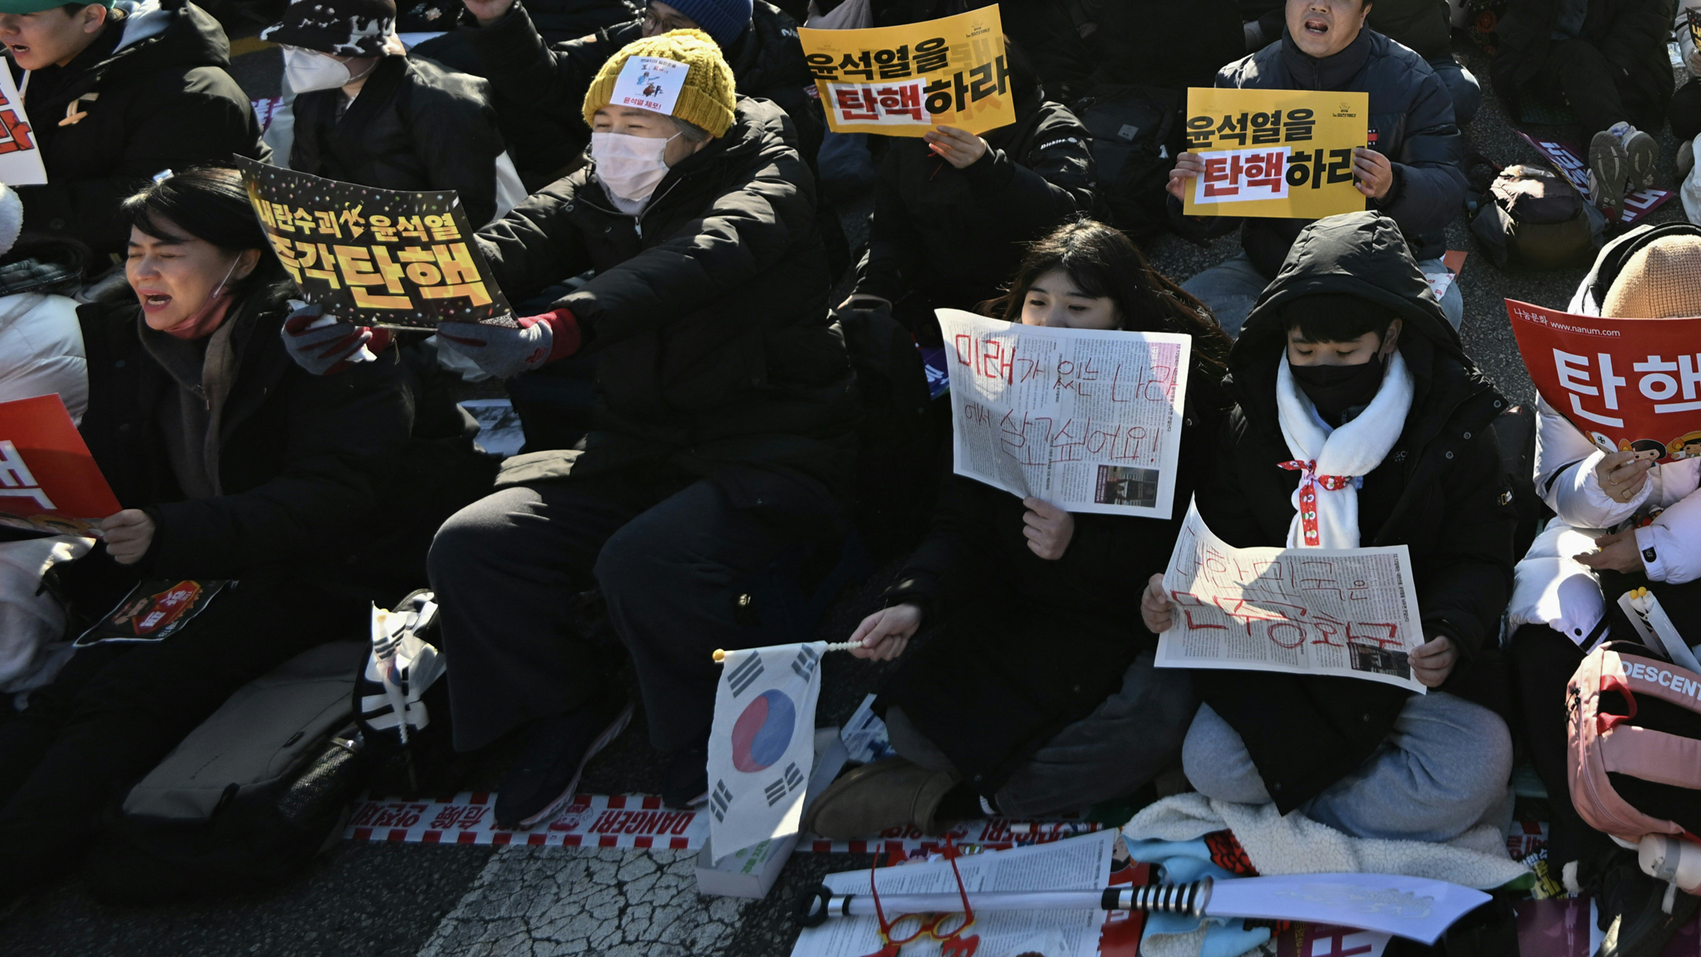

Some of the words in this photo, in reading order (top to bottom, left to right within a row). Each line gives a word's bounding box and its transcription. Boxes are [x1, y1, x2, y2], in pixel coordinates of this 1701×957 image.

[806, 35, 950, 82] 윤석열을
[837, 53, 1009, 123] 탄핵하라
[1185, 107, 1317, 149] 윤석열을
[1201, 145, 1360, 198] 탄핵하라
[370, 213, 456, 244] 윤석열
[1513, 306, 1549, 327] 나눔문화
[1549, 321, 1622, 339] www.nanum.com
[1111, 363, 1181, 404] 나라
[589, 810, 696, 834] DANGER!
